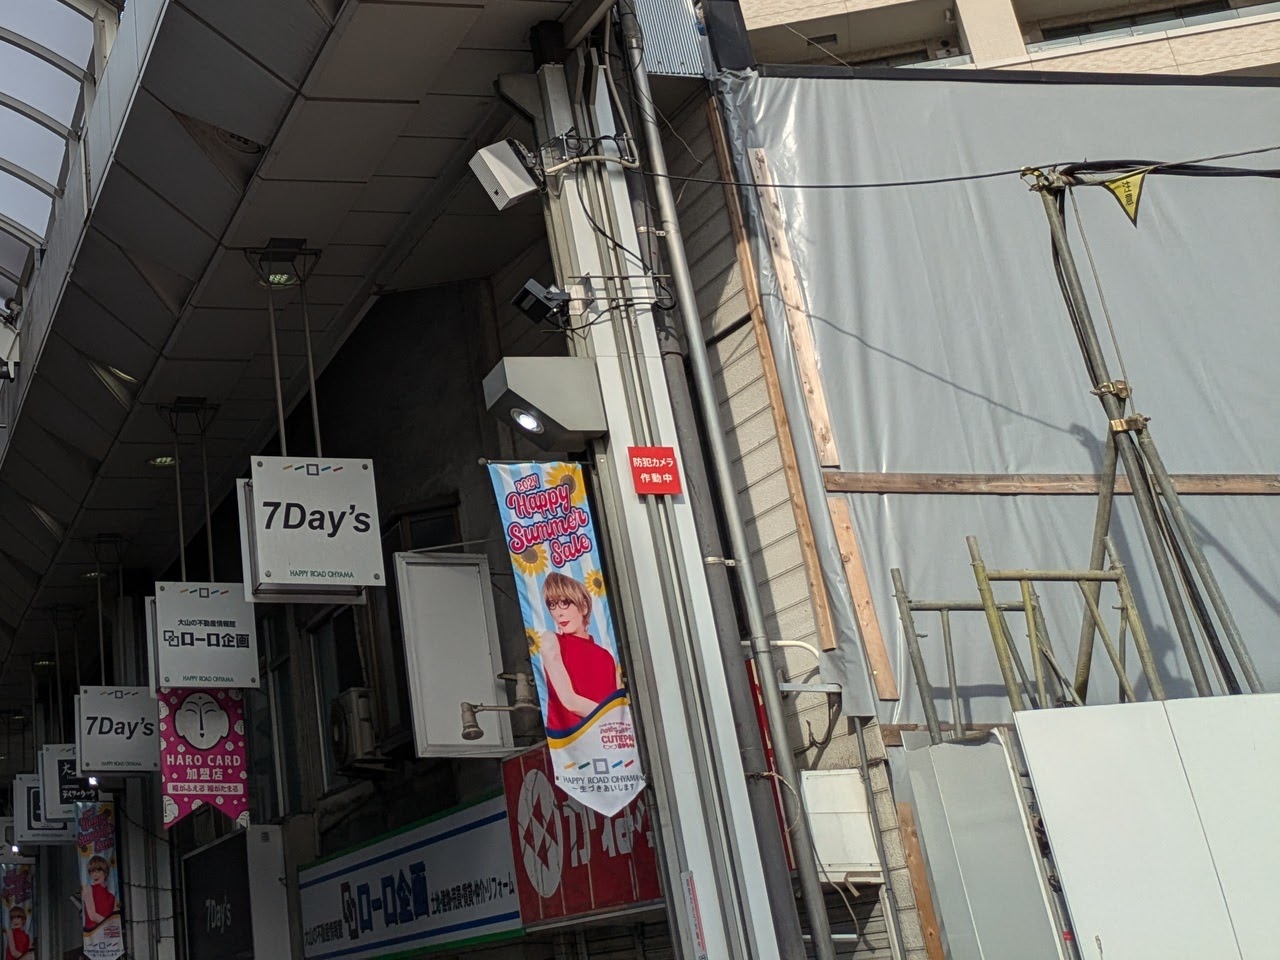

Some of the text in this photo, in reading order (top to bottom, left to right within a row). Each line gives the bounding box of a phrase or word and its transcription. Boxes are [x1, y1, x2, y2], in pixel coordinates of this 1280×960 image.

[633, 457, 674, 467] 防犯カメラ
[515, 474, 540, 493] 2024
[640, 472, 673, 483] 作動中
[506, 484, 571, 518] Happy
[262, 501, 370, 538] 7Day's
[508, 507, 589, 555] Summer
[550, 534, 593, 569] Sale
[290, 569, 309, 577] HAPPY
[327, 570, 355, 578] OHYAMA
[177, 619, 236, 628] 大山の不動産情報館
[85, 716, 155, 740] 7Day's
[166, 754, 241, 766] HARO CARD
[185, 767, 224, 780] 加盟店
[563, 775, 585, 784] HAPPY
[587, 776, 609, 784] ROAD
[572, 783, 635, 792] 一生づきあいします
